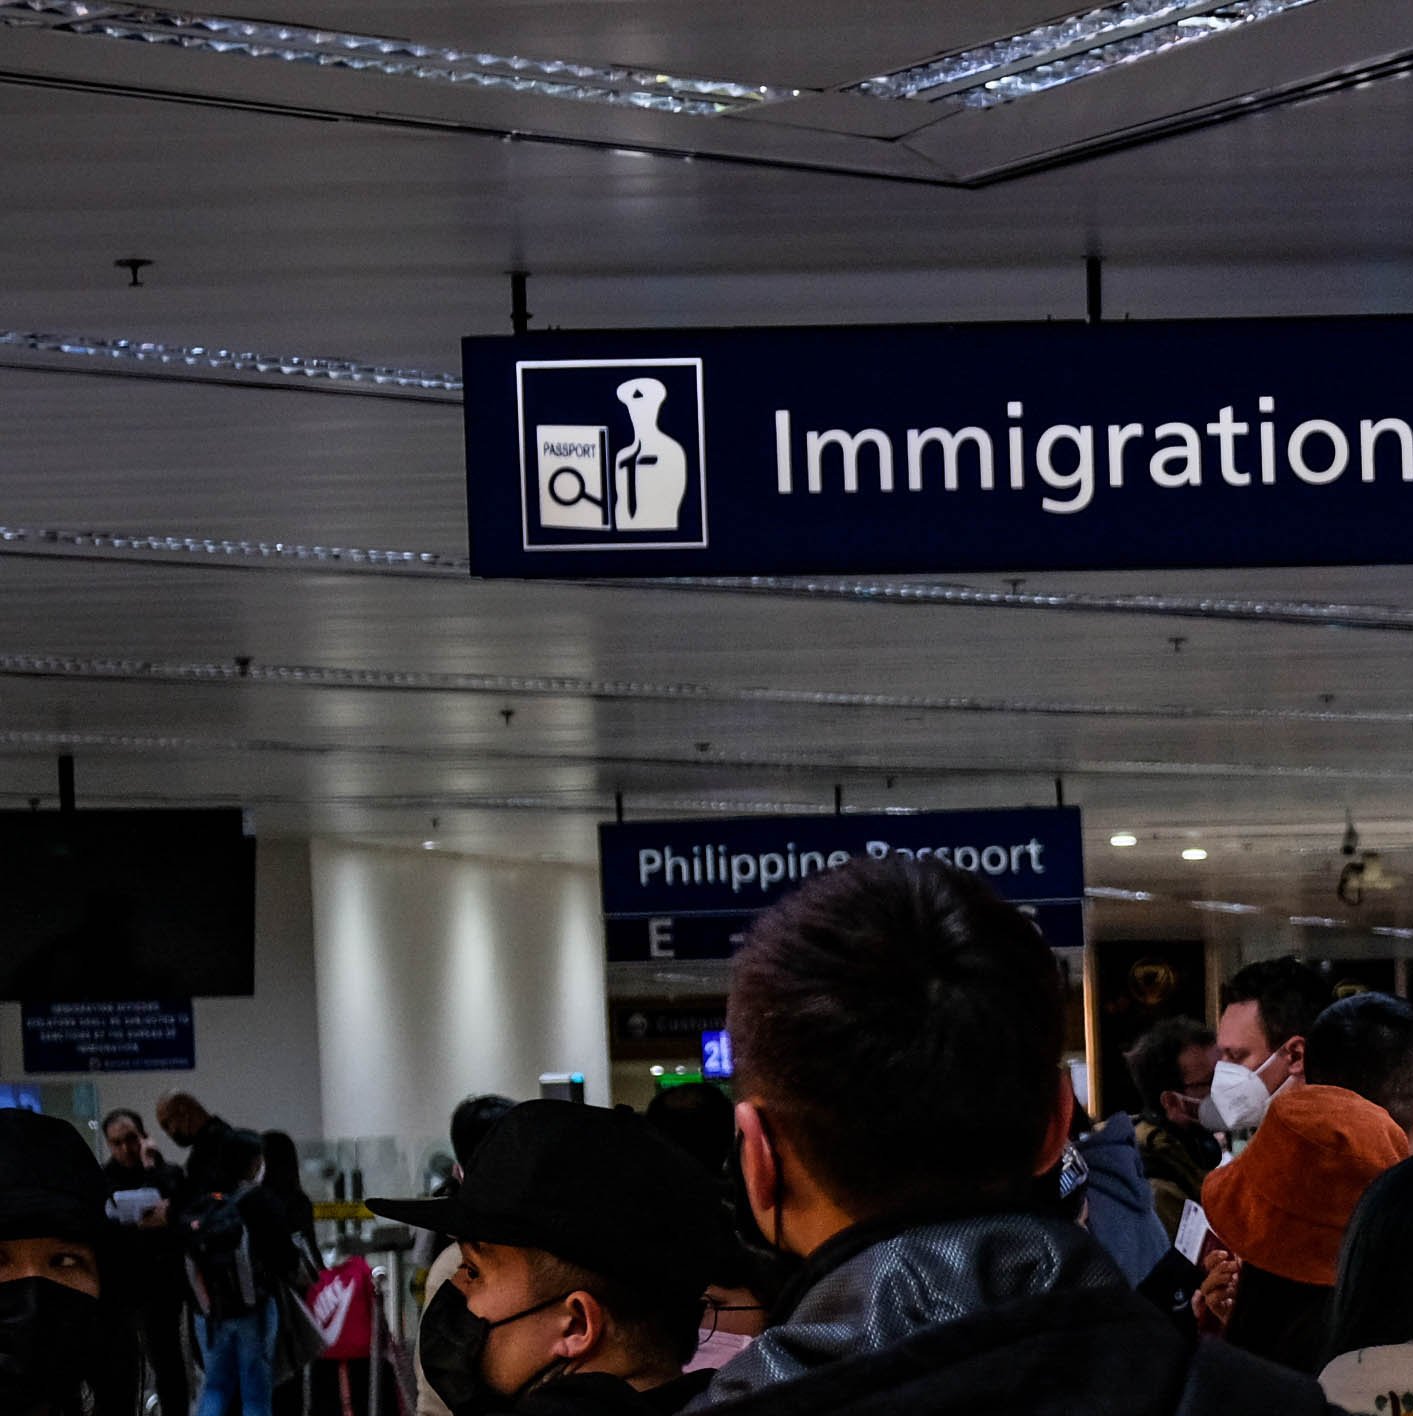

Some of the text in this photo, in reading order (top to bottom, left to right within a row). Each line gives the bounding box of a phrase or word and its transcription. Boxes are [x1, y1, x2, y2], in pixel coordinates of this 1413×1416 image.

[543, 441, 596, 458] PASSPORT
[638, 837, 1047, 893] Philippine Psport
[648, 916, 675, 958] E
